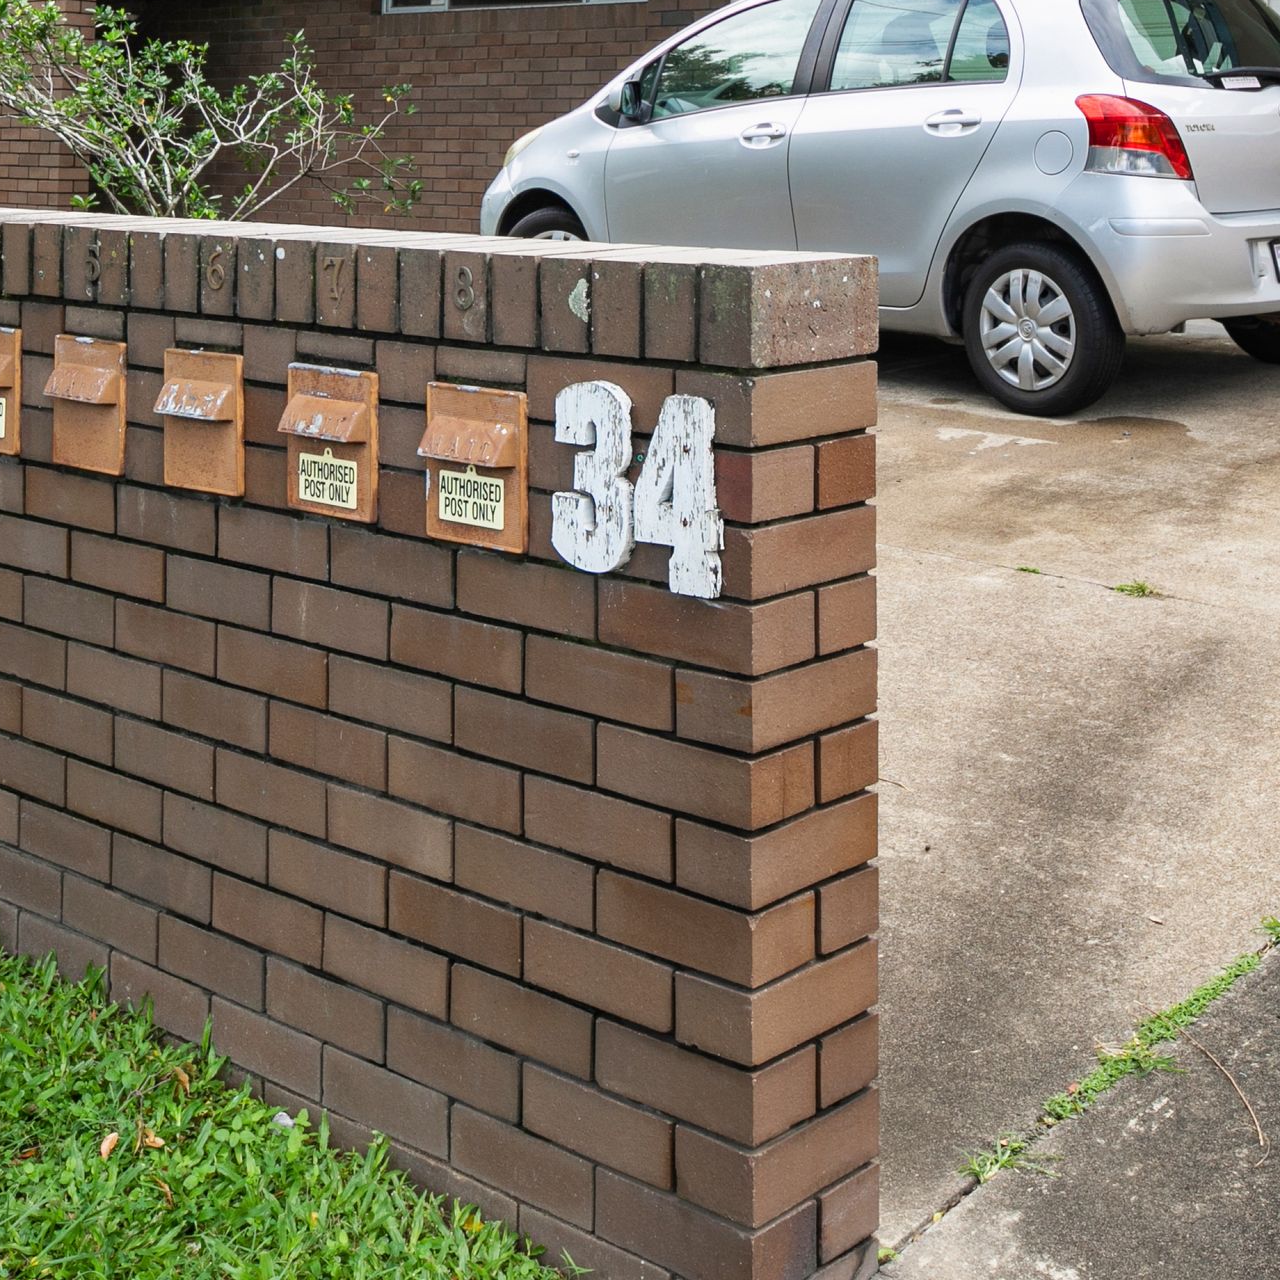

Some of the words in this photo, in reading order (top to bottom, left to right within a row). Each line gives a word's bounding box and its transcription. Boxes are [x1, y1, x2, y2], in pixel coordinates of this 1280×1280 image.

[85, 244, 100, 283] 5
[207, 251, 225, 290] 6
[323, 256, 345, 301] 7
[455, 265, 474, 311] 8
[300, 458, 355, 485] AUTHORISED
[304, 478, 326, 499] POST
[329, 483, 351, 504] ONLY
[440, 475, 502, 503] AUTHORISED
[551, 380, 724, 599] 34
[444, 496, 469, 519] POST
[472, 501, 497, 523] ONLY
